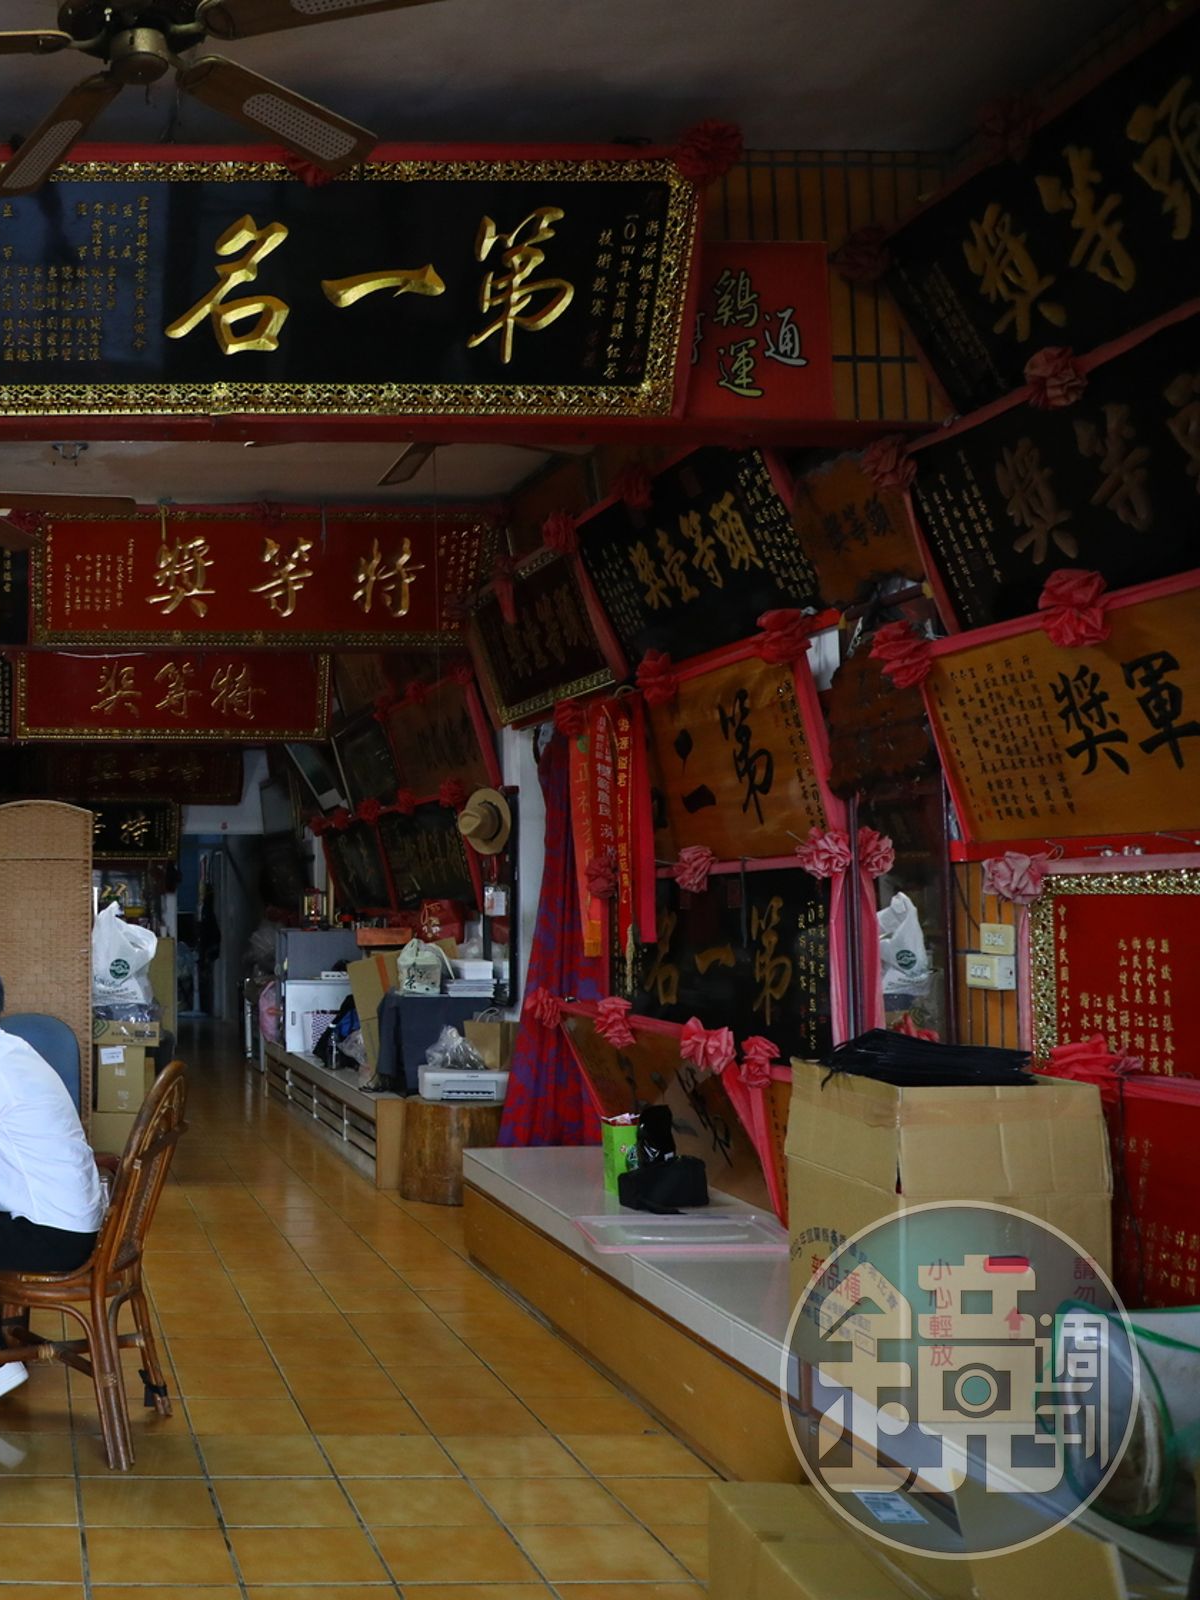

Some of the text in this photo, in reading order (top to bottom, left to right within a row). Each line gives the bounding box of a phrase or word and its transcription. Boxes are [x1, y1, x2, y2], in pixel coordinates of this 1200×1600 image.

[164, 205, 576, 366] 第一名
[762, 306, 808, 368] 通
[145, 535, 425, 618] 特等獎
[629, 490, 764, 611] 頭等壹獎
[653, 687, 774, 825] 第二
[644, 896, 793, 1026] 第一名
[927, 1258, 953, 1369] 小心輕放
